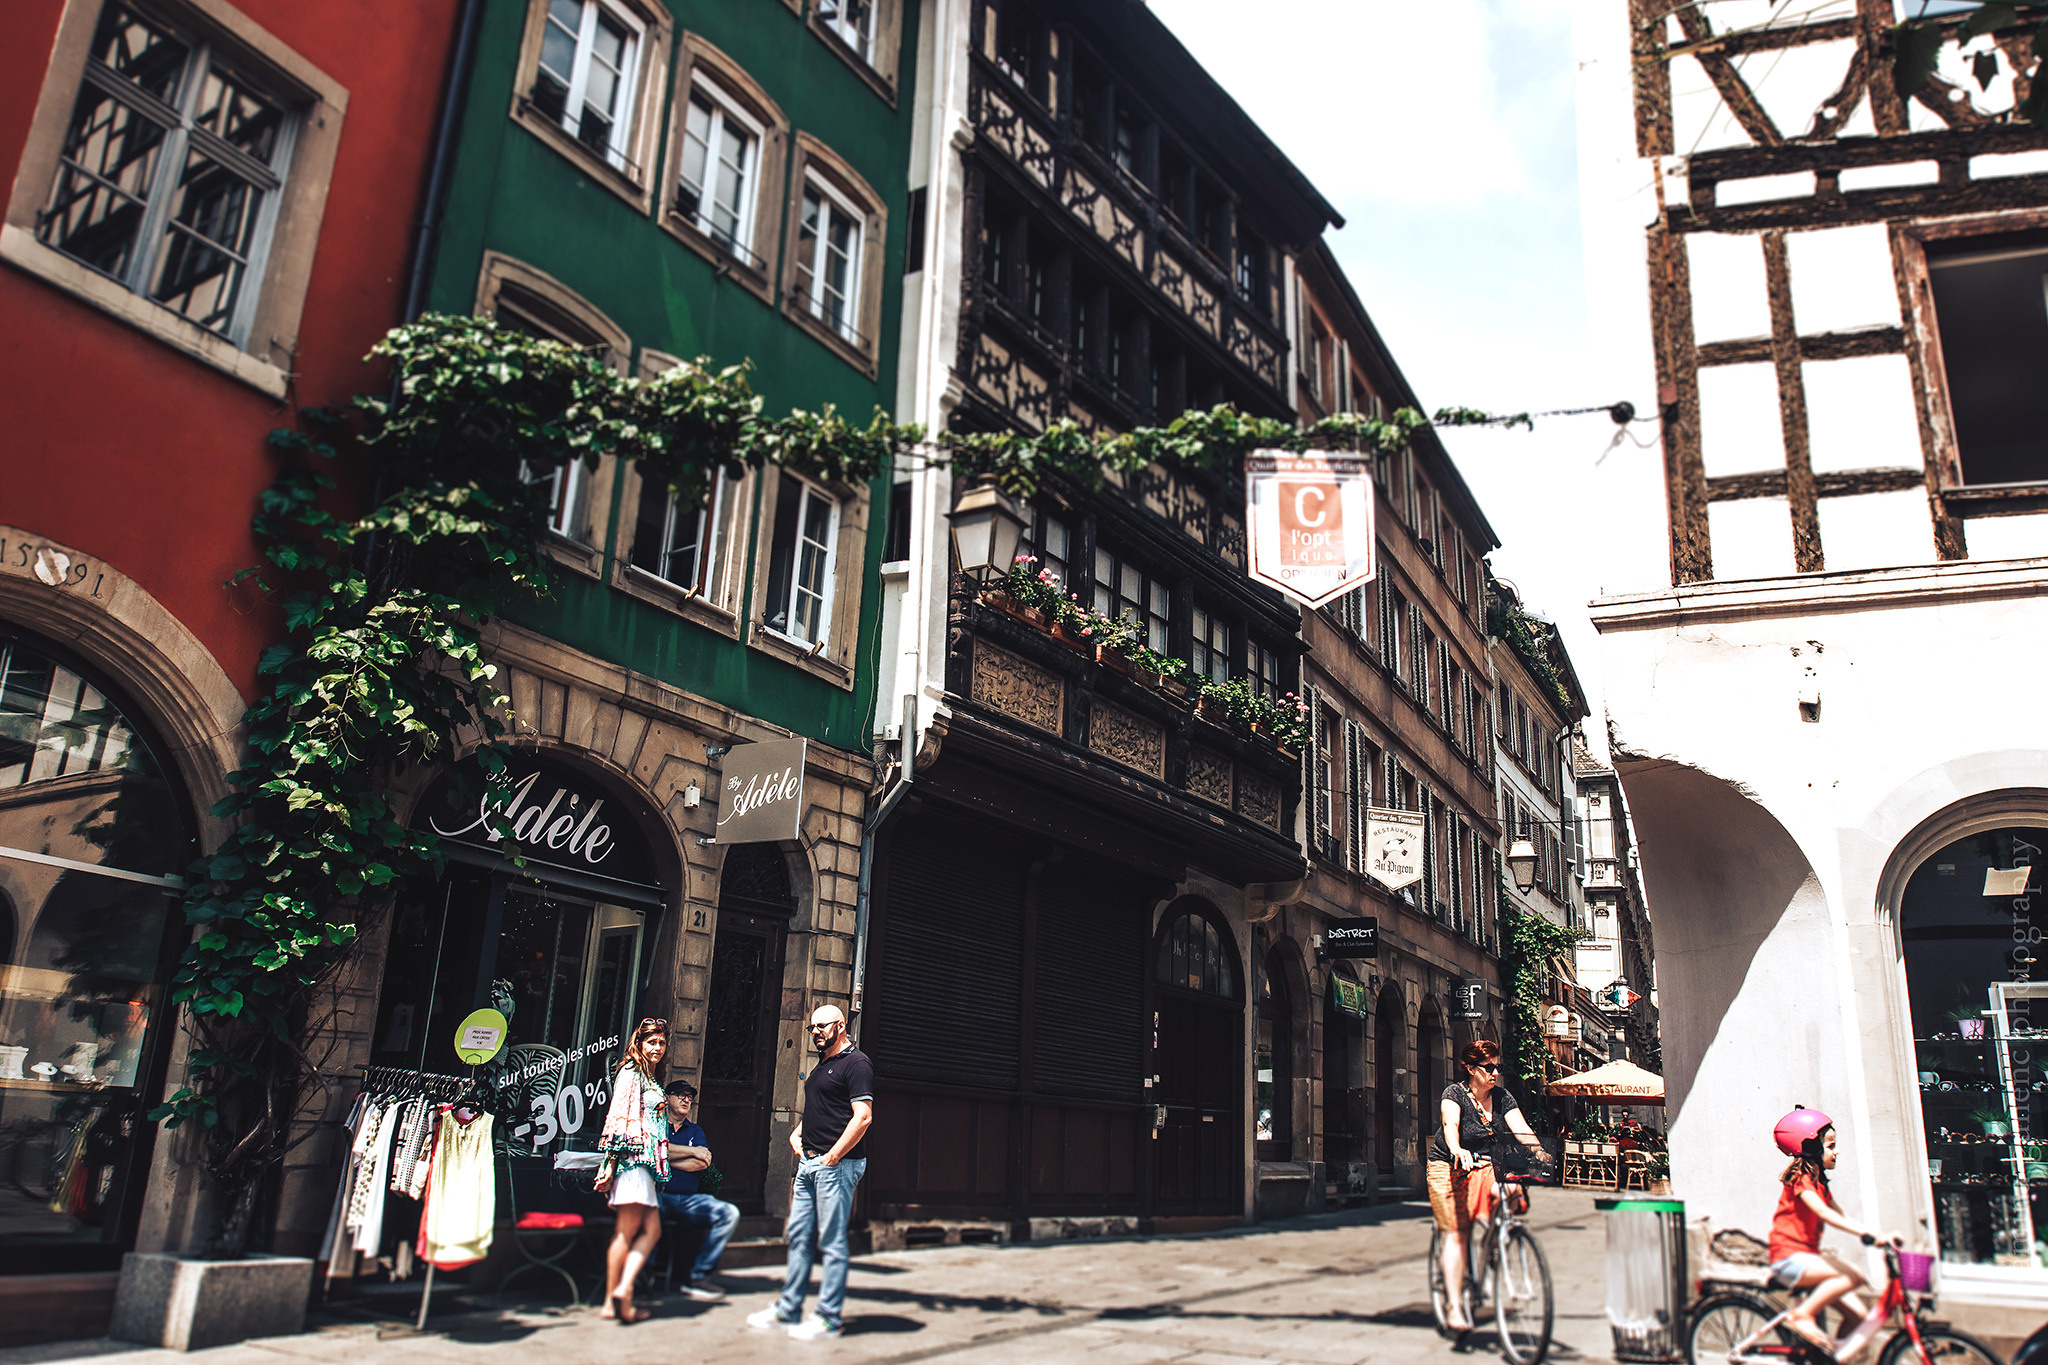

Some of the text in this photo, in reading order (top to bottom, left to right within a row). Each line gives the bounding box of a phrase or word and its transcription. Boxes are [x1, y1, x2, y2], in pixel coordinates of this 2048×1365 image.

[1295, 486, 1326, 528] C
[727, 775, 743, 791] By
[717, 766, 801, 826] Adèle
[1373, 826, 1418, 841] RESTAURANT
[1374, 859, 1414, 875] Au Pigeon
[694, 910, 707, 928] 21
[499, 1034, 619, 1089] sur toutes les robes
